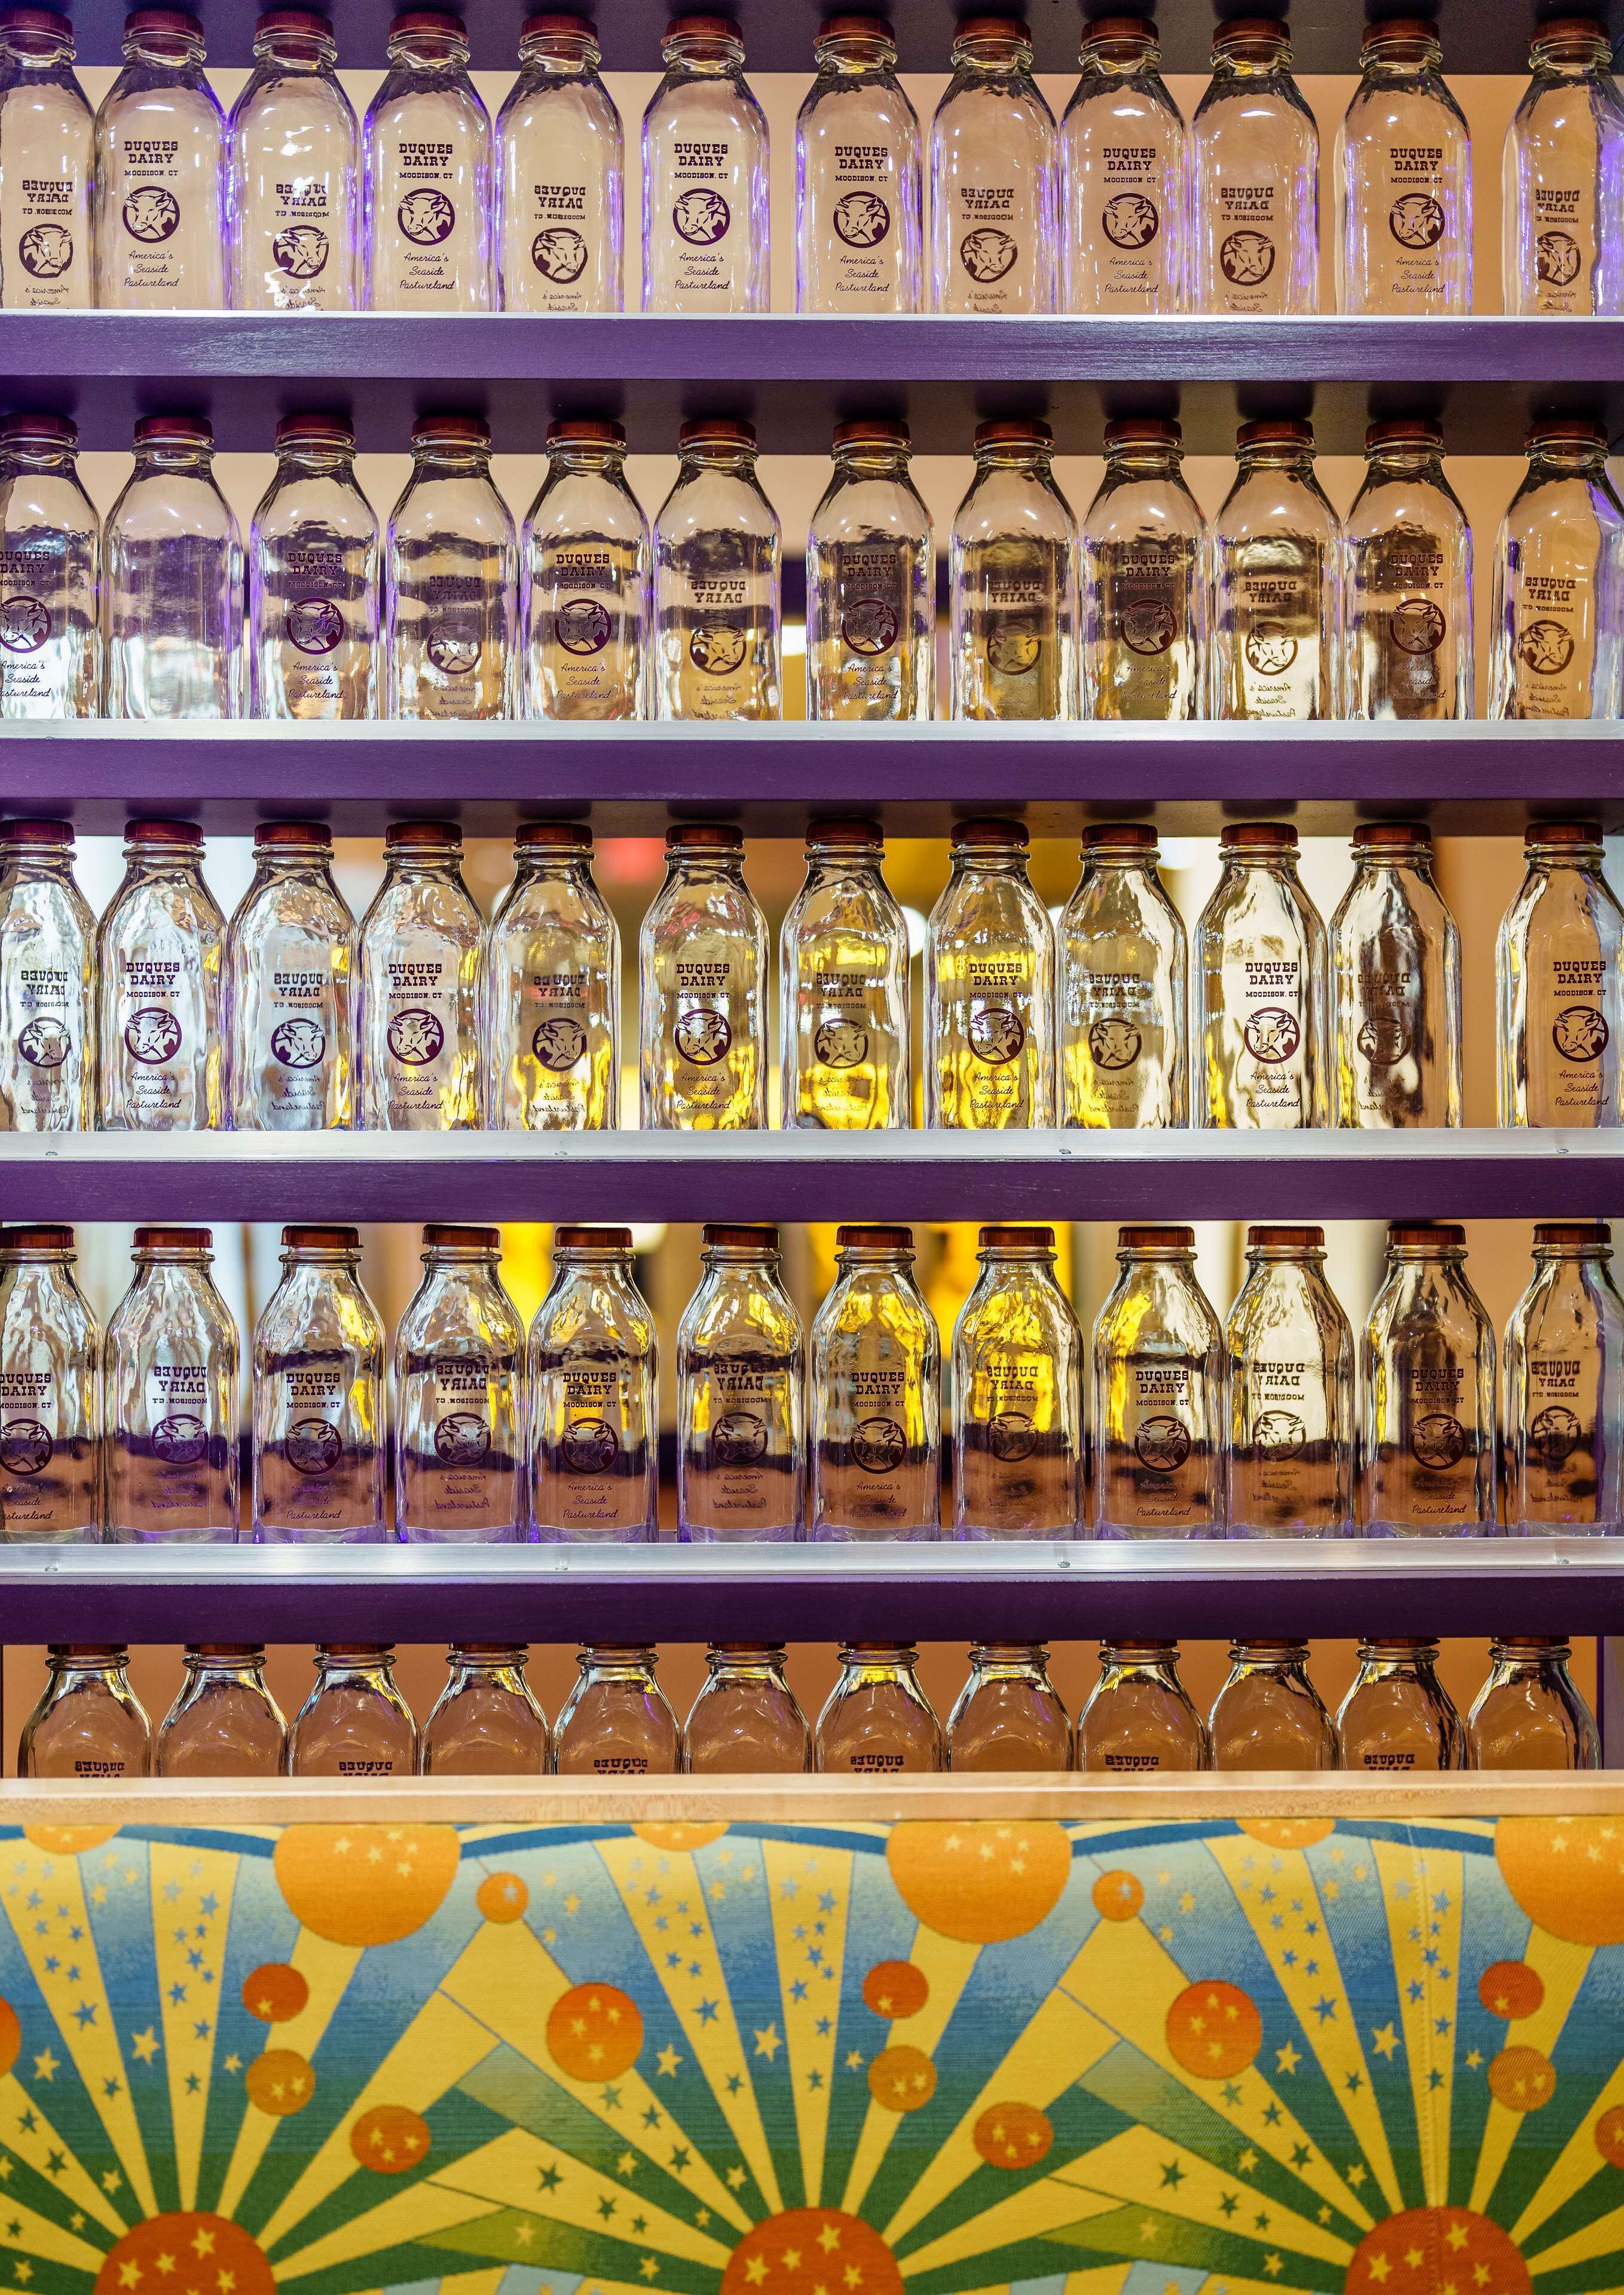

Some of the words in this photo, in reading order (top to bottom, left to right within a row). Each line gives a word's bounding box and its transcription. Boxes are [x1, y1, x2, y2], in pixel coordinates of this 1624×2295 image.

[124, 141, 178, 153] DUQUES
[399, 143, 452, 155] DUQUES
[674, 143, 728, 155] DUQUES
[835, 146, 888, 158] DUQUES
[129, 154, 173, 164] DAIRY
[1103, 148, 1156, 160] DUQUES
[1390, 148, 1442, 160] DUQUES
[403, 156, 448, 166] DAIRY
[678, 156, 724, 166] DAIRY
[839, 159, 883, 169] DAIRY
[1108, 161, 1152, 171] DAIRY
[1394, 161, 1438, 171] DAIRY
[129, 249, 174, 260] America's
[404, 252, 449, 262] America's
[679, 252, 724, 262] America's
[840, 255, 884, 265] America's
[1109, 256, 1153, 266] America's
[1396, 256, 1439, 266] America's
[134, 263, 169, 273] Seaside
[409, 265, 444, 275] Seaside
[684, 265, 720, 275] Seaside
[845, 268, 879, 278] Seaside
[1114, 270, 1148, 279] Seaside
[1401, 270, 1435, 279] Seaside
[124, 276, 179, 287] Pastureland
[400, 279, 455, 289] Pastureland
[675, 279, 730, 289] Pastureland
[836, 281, 890, 292] Pastureland
[1105, 283, 1159, 293] Pastureland
[1391, 283, 1445, 293] Pastureland
[556, 554, 609, 565] DUQUES
[843, 555, 896, 566] DUQUES
[1122, 555, 1175, 566] DUQUES
[1390, 554, 1443, 566] DUQUES
[0, 564, 45, 574] DAIRY
[292, 565, 338, 576] DAIRY
[560, 566, 605, 577] DAIRY
[847, 567, 892, 577] DAIRY
[1126, 567, 1170, 577] DAIRY
[1394, 566, 1439, 577] DAIRY
[0, 659, 45, 670] America's
[293, 661, 338, 671] America's
[561, 662, 605, 672] America's
[848, 662, 892, 673] America's
[5, 674, 40, 683] Seaside
[298, 675, 334, 684] Seaside
[566, 676, 601, 686] Seaside
[853, 676, 888, 686] Seaside
[289, 688, 344, 699] Pastureland
[126, 963, 180, 974] DUQUES
[389, 964, 442, 975] DUQUES
[677, 964, 730, 975] DUQUES
[969, 963, 1022, 975] DUQUES
[1246, 963, 1298, 974] DUQUES
[1553, 961, 1606, 973] DUQUES
[130, 975, 176, 986] DAIRY
[393, 976, 438, 987] DAIRY
[681, 976, 726, 987] DAIRY
[974, 975, 1018, 986] DAIRY
[1249, 975, 1293, 986] DAIRY
[1558, 973, 1602, 984] DAIRY
[130, 1070, 176, 1082] America's
[393, 1072, 438, 1083] America's
[681, 1072, 726, 1082] America's
[974, 1071, 1019, 1082] America's
[1250, 1070, 1295, 1081] America's
[1559, 1068, 1604, 1079] America's
[136, 1085, 171, 1094] Seaside
[398, 1086, 433, 1096] Seaside
[686, 1086, 721, 1096] Seaside
[979, 1085, 1014, 1095] Seaside
[1256, 1084, 1290, 1094] Seaside
[1564, 1082, 1599, 1093] Seaside
[126, 1097, 182, 1109] Pastureland
[389, 1098, 444, 1110] Pastureland
[677, 1098, 732, 1110] Pastureland
[970, 1098, 1024, 1109] Pastureland
[1246, 1097, 1300, 1108] Pastureland
[1555, 1095, 1610, 1107] Pastureland
[286, 1373, 340, 1385] DUQUES
[563, 1373, 616, 1384] DUQUES
[851, 1372, 904, 1384] DUQUES
[1136, 1371, 1189, 1382] DUQUES
[1, 1385, 47, 1397] DAIRY
[290, 1385, 336, 1396] DAIRY
[567, 1385, 612, 1396] DAIRY
[855, 1384, 900, 1395] DAIRY
[1140, 1383, 1185, 1394] DAIRY
[1415, 1381, 1460, 1392] DAIRY
[567, 1480, 612, 1492] America's
[857, 1480, 901, 1491] America's
[573, 1495, 607, 1504] Seaside
[1422, 1490, 1456, 1500] Seaside
[286, 1508, 342, 1520] Pastureland
[563, 1507, 618, 1519] Pastureland
[1137, 1505, 1191, 1517] Pastureland
[1412, 1503, 1467, 1515] Pastureland
